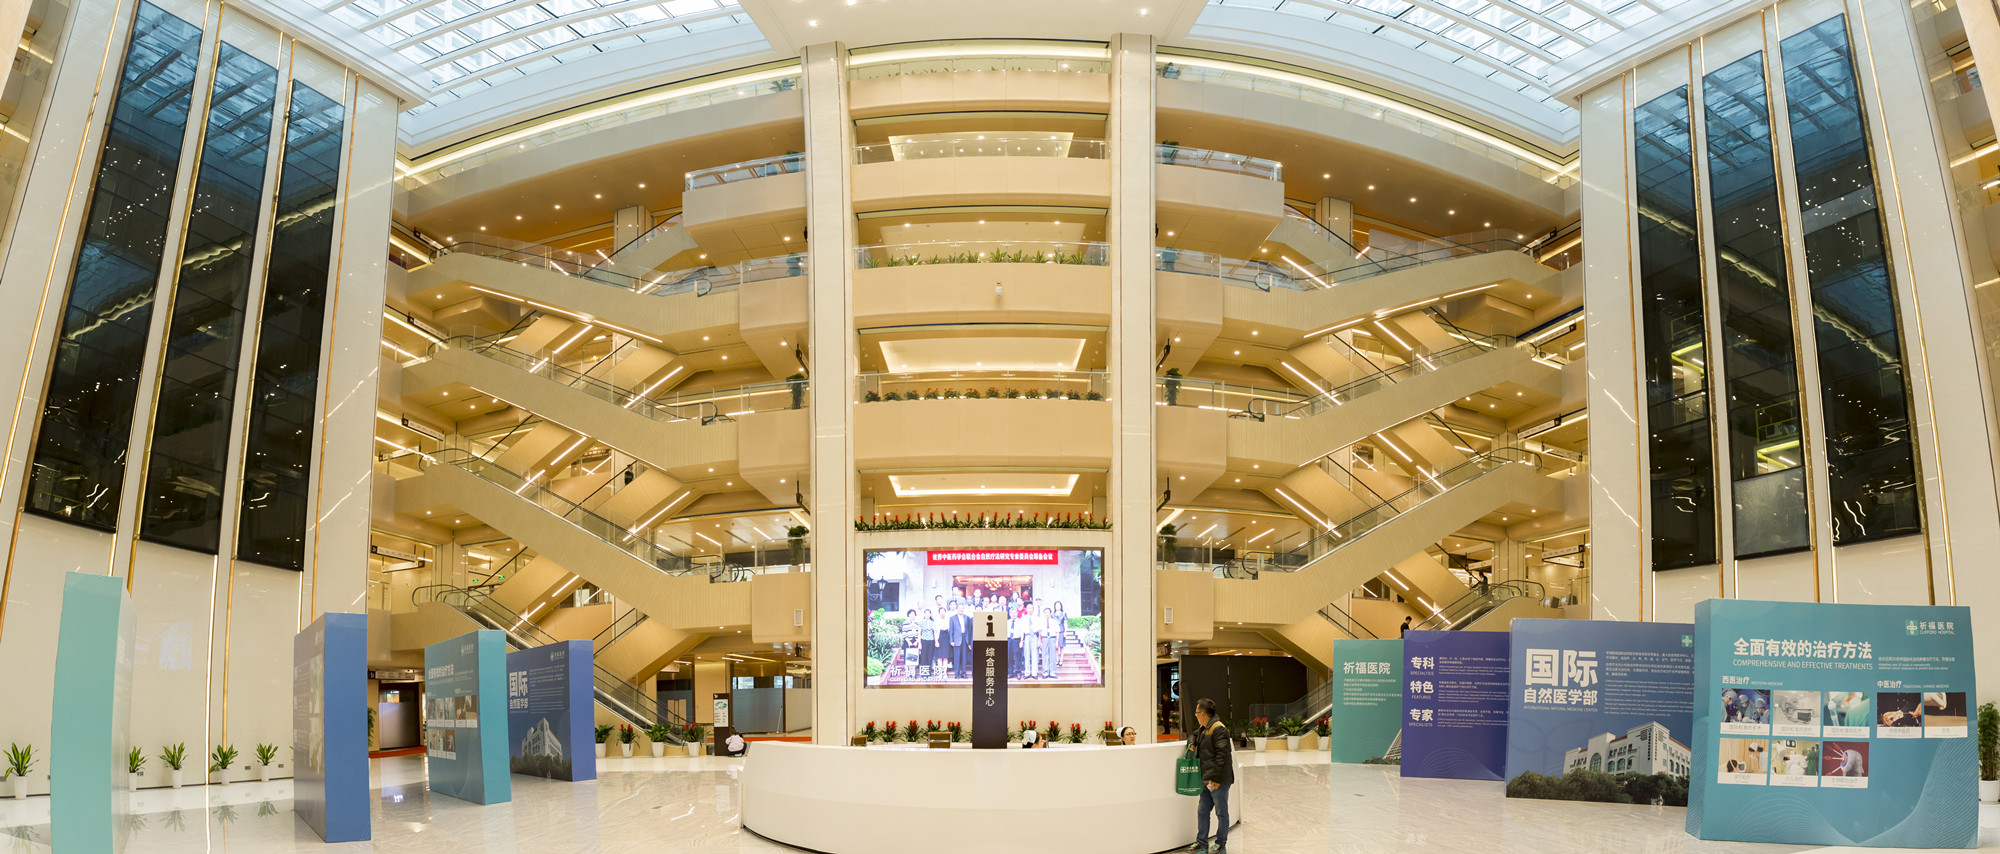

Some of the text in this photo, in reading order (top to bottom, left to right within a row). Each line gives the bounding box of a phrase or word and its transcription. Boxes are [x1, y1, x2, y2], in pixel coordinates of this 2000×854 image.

[1919, 621, 1954, 630] 祈福医院
[1733, 637, 1872, 659] 全面有效的治疗方法
[1343, 661, 1391, 675] 祈福医院
[1410, 656, 1435, 670] 专科
[1525, 648, 1598, 688] 国际
[1732, 659, 1787, 669] COMPREHENSIVE
[1787, 661, 1801, 669] AND
[1801, 661, 1834, 670] EFFECTIVE
[1834, 662, 1873, 671] TREATMENTS
[985, 647, 996, 707] 综合服务中心
[1722, 675, 1750, 685] 西医治疗
[509, 671, 528, 698] 国际
[1410, 680, 1434, 694] 特色
[1876, 680, 1902, 689] 中医治疗
[1523, 688, 1598, 706] 自然医学部
[1409, 708, 1434, 722] 专家
